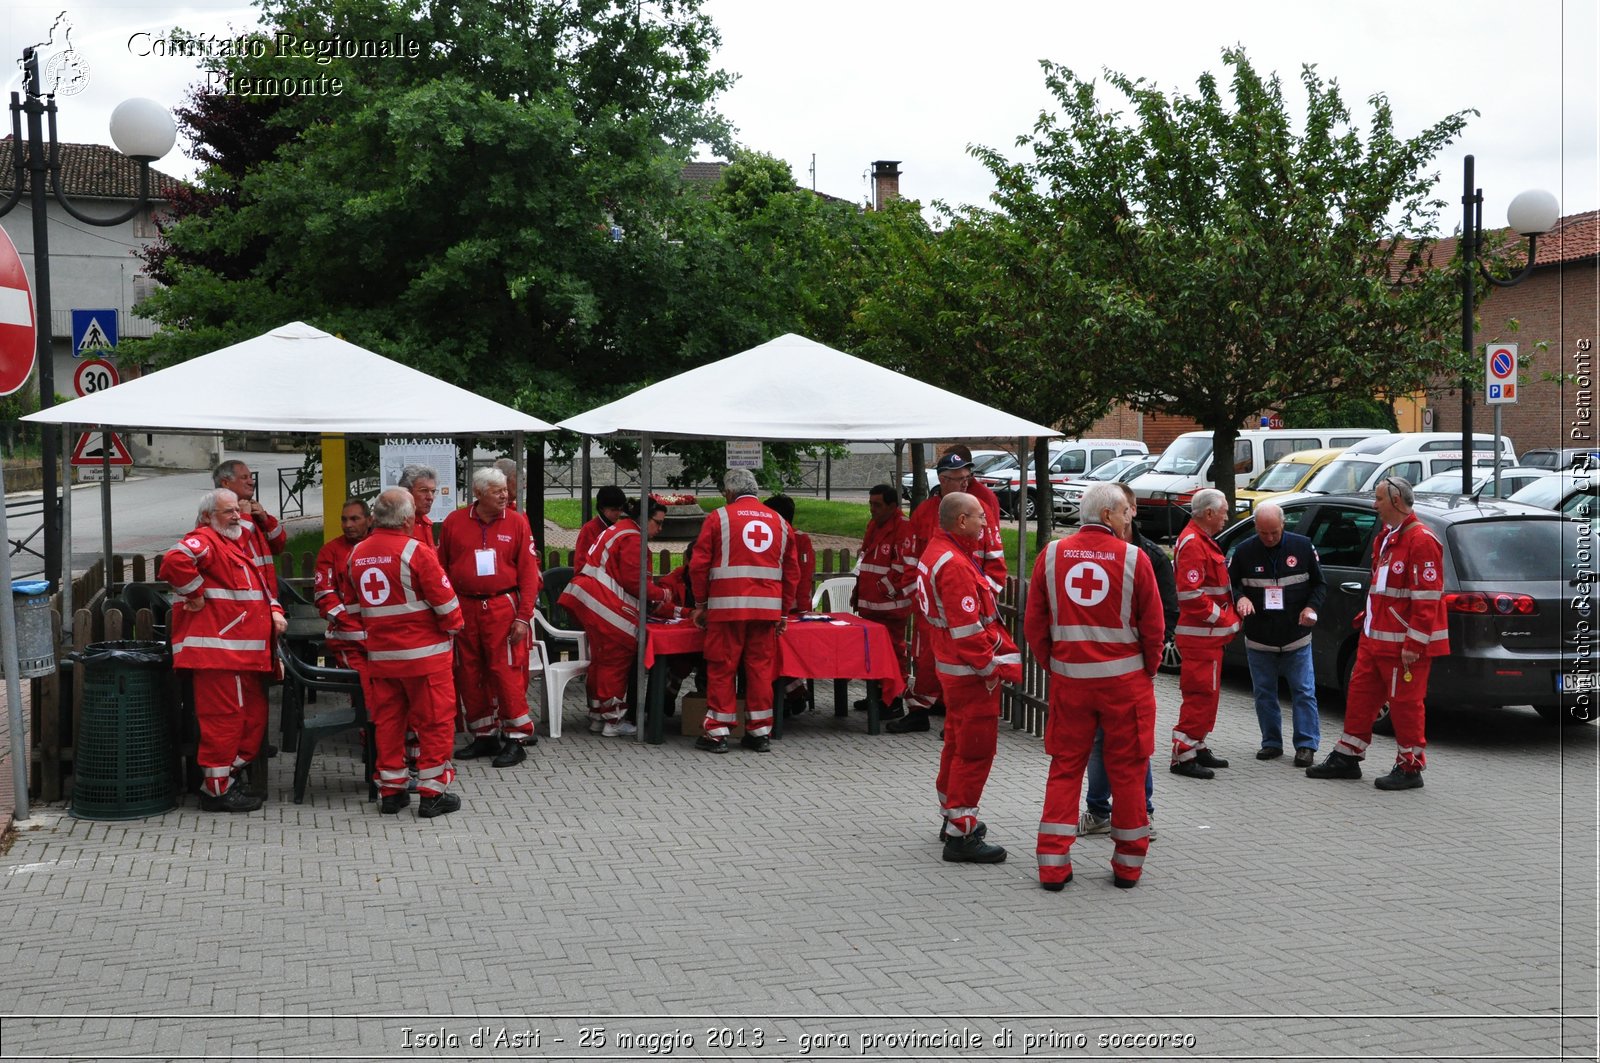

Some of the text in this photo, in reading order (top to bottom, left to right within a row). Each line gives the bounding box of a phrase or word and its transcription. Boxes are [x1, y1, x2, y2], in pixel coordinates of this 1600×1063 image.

[85, 372, 109, 393] 30
[1492, 386, 1499, 397] P
[385, 438, 418, 446] ISOLA
[1064, 549, 1116, 560] CROCE ROSSA ITALIANA
